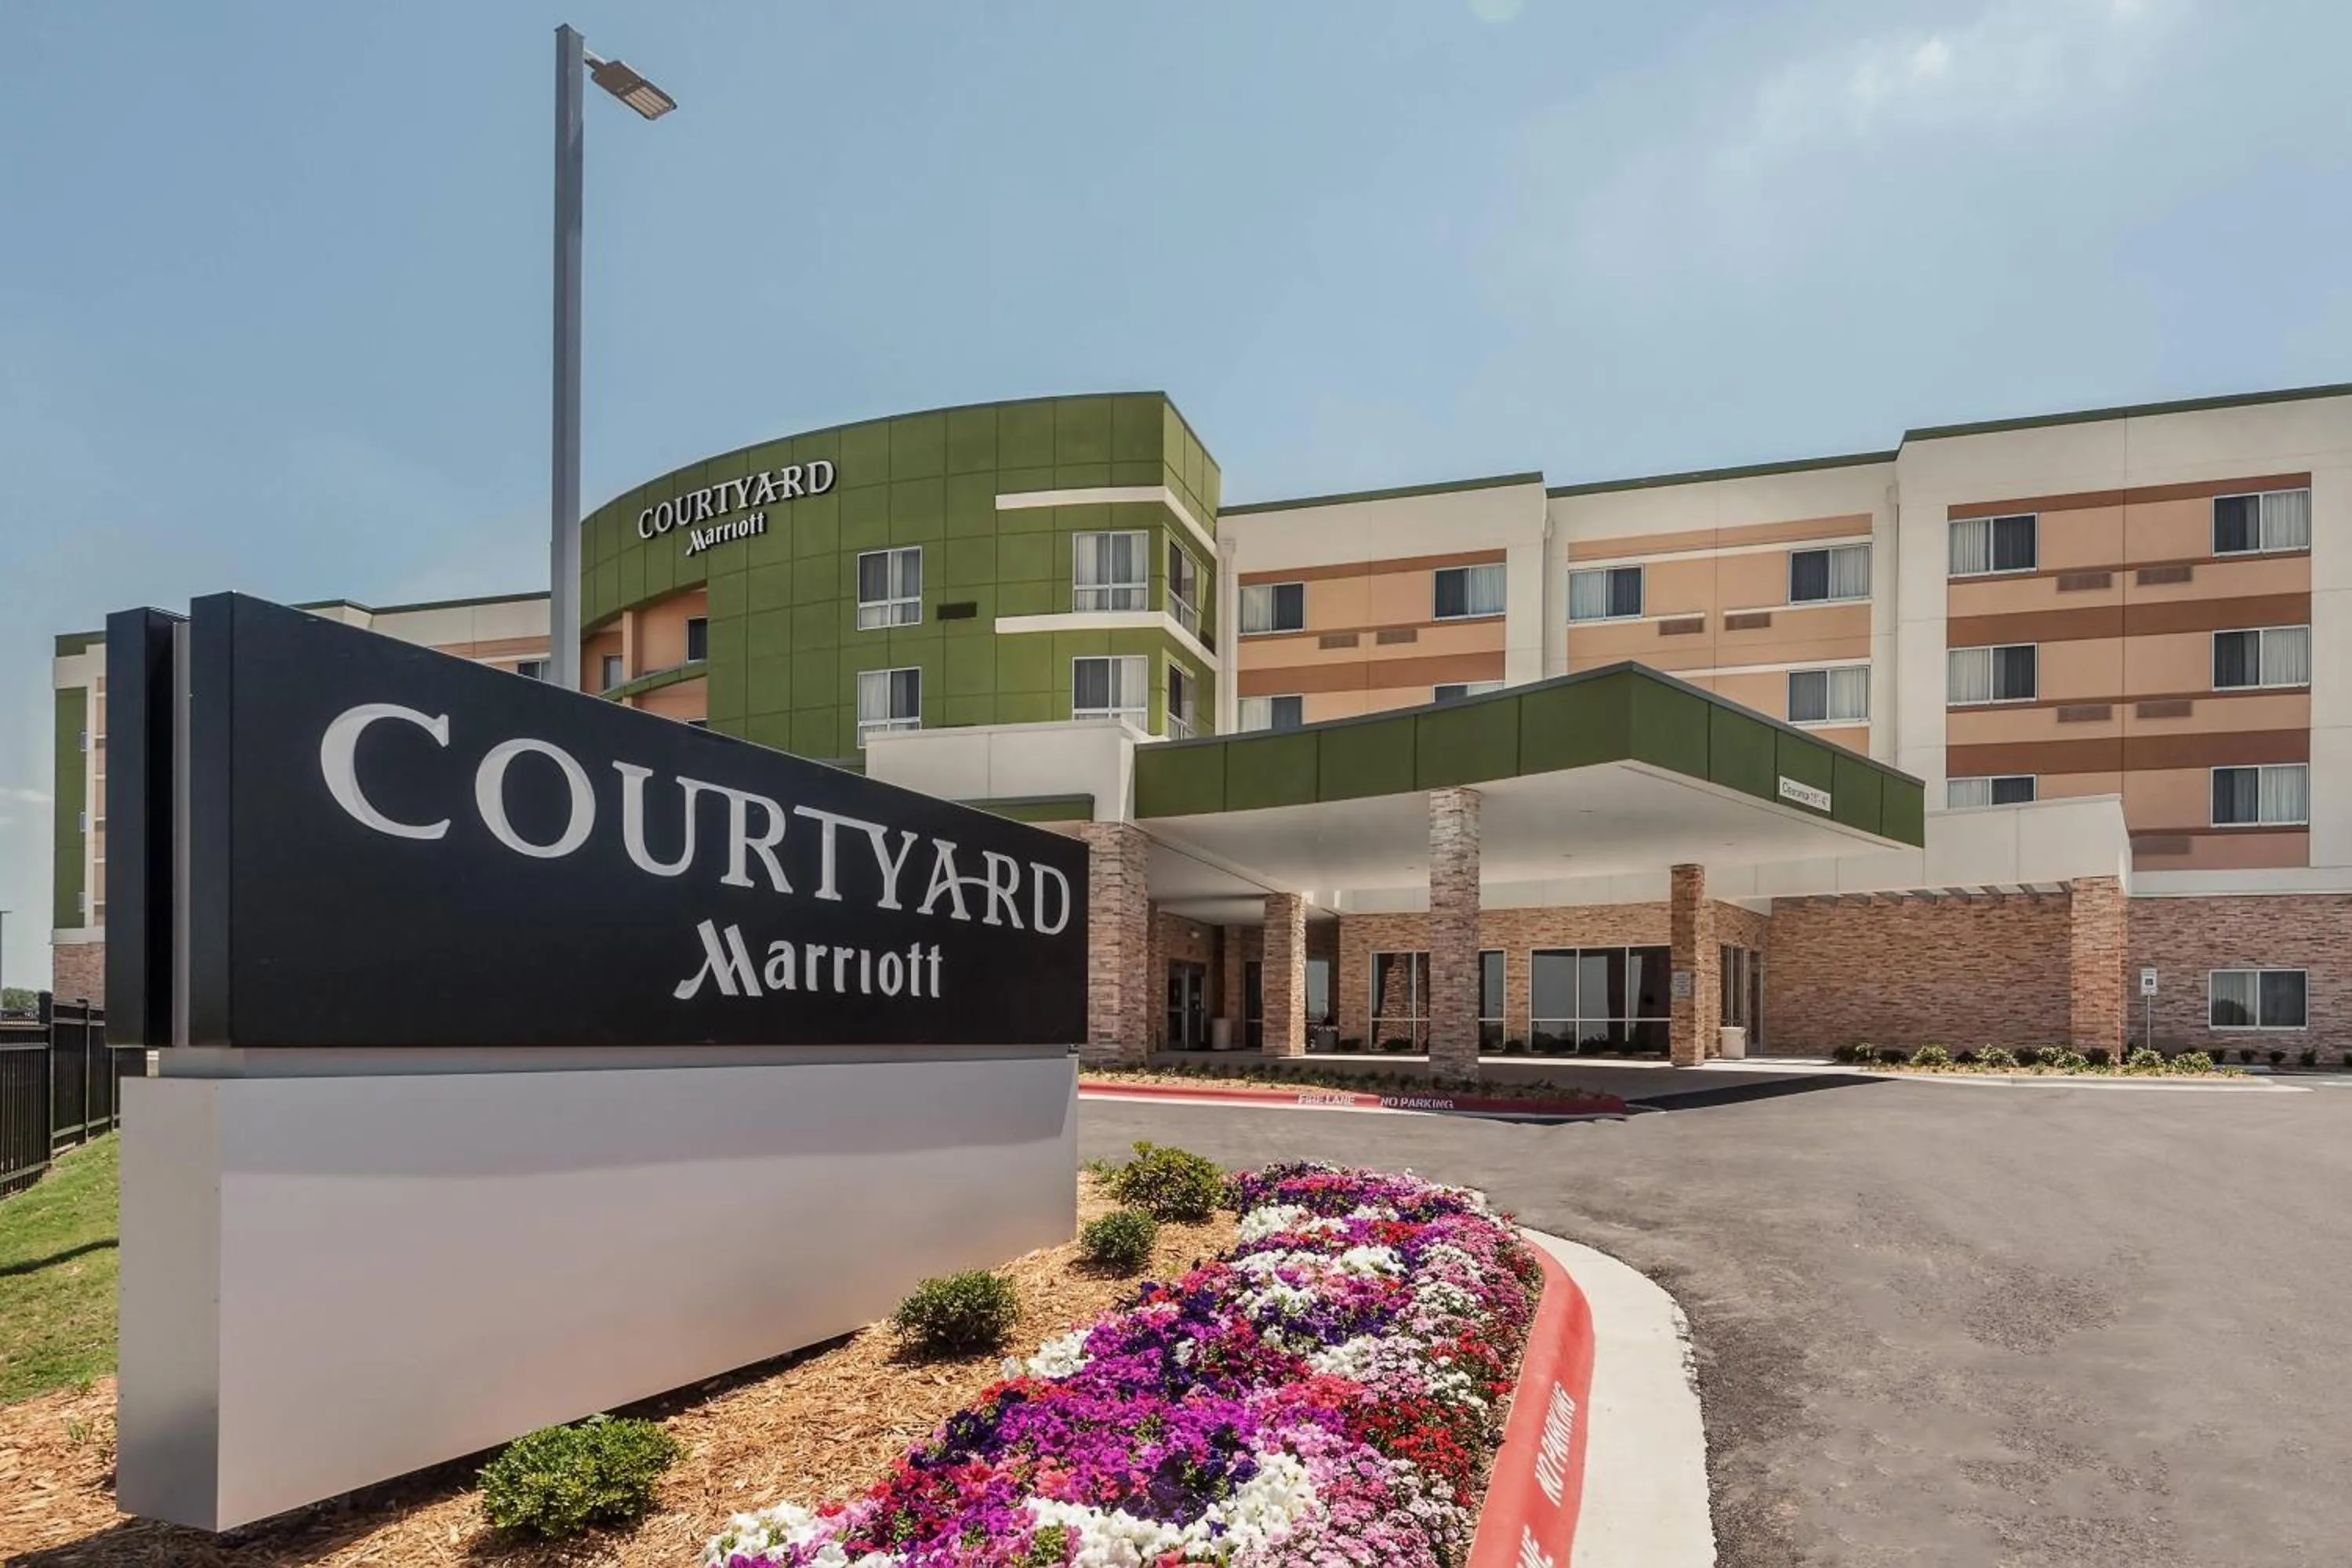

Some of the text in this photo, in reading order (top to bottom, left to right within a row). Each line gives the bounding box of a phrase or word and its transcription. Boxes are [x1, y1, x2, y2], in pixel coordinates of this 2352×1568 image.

[637, 459, 835, 539] COURTYARD
[685, 511, 765, 556] Marriott
[320, 702, 1071, 935] COURTYARD
[673, 919, 942, 1000] Marriott
[1298, 1094, 1454, 1109] FIRE LANE NO PARKING
[1541, 1381, 1577, 1474] PARKING
[1534, 1452, 1563, 1508] NO
